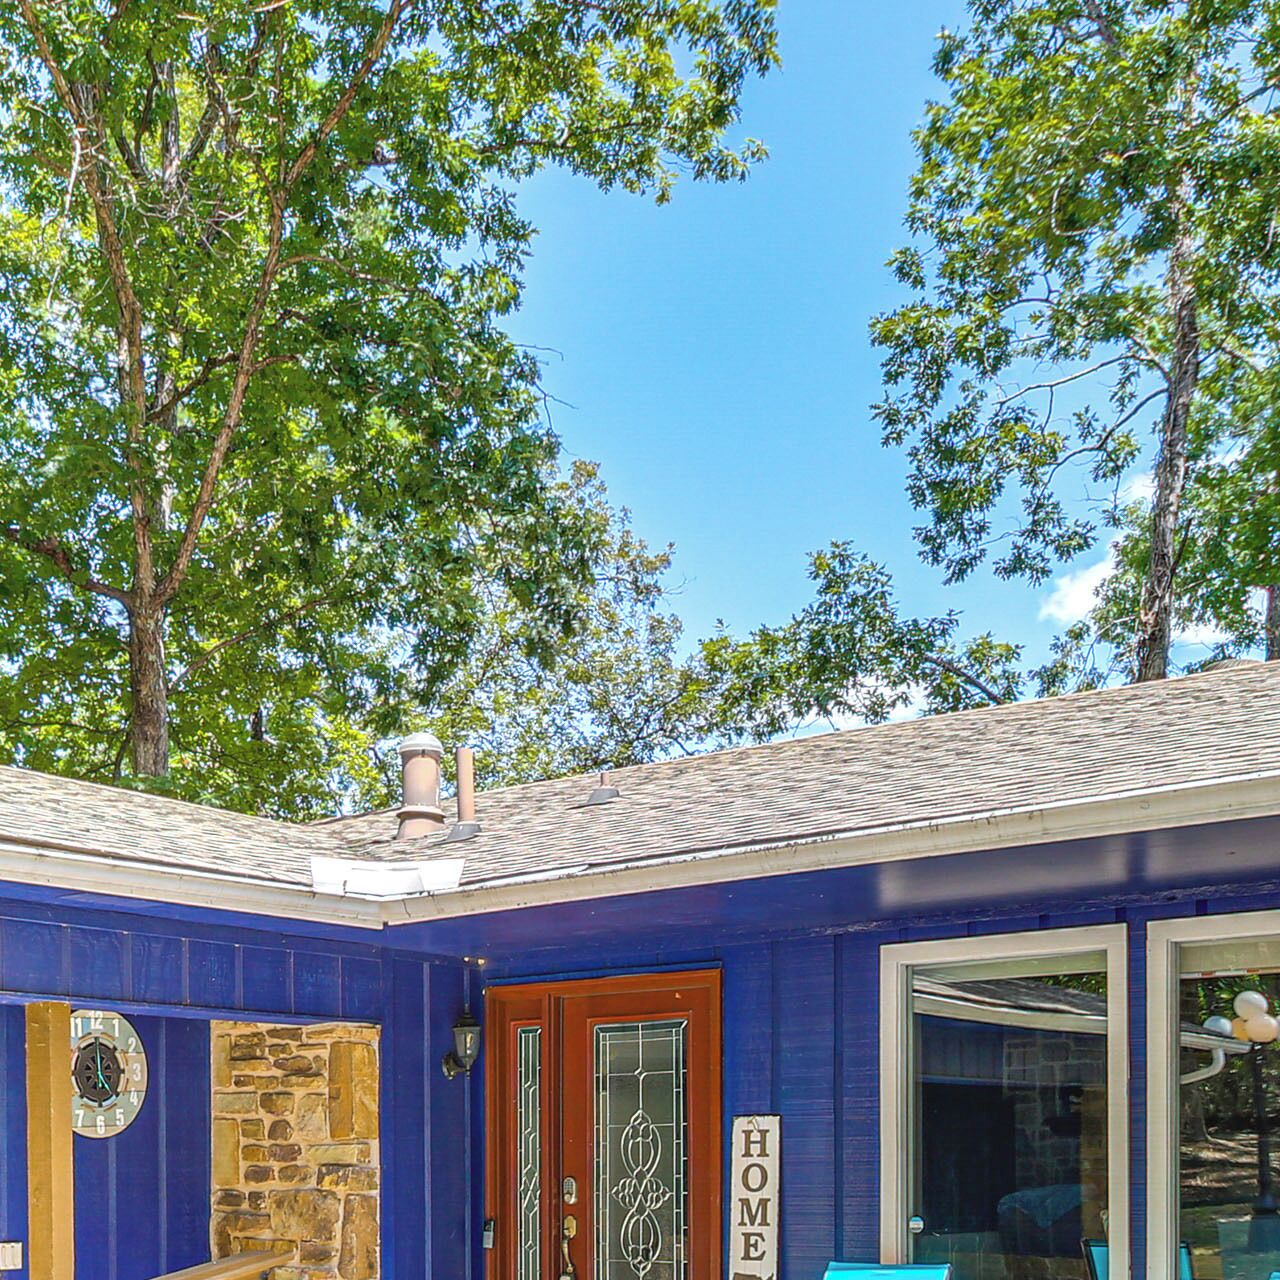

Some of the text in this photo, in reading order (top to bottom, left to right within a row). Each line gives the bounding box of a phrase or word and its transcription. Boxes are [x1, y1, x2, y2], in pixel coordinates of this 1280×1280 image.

[90, 1010, 103, 1030] 12
[112, 1018, 119, 1037] 1
[128, 1037, 136, 1055] 2
[132, 1063, 141, 1082] 3
[129, 1088, 138, 1106] 4
[75, 1109, 84, 1127] 7
[96, 1115, 105, 1135] 6
[115, 1108, 124, 1126] 5
[738, 1129, 771, 1261] HOME
